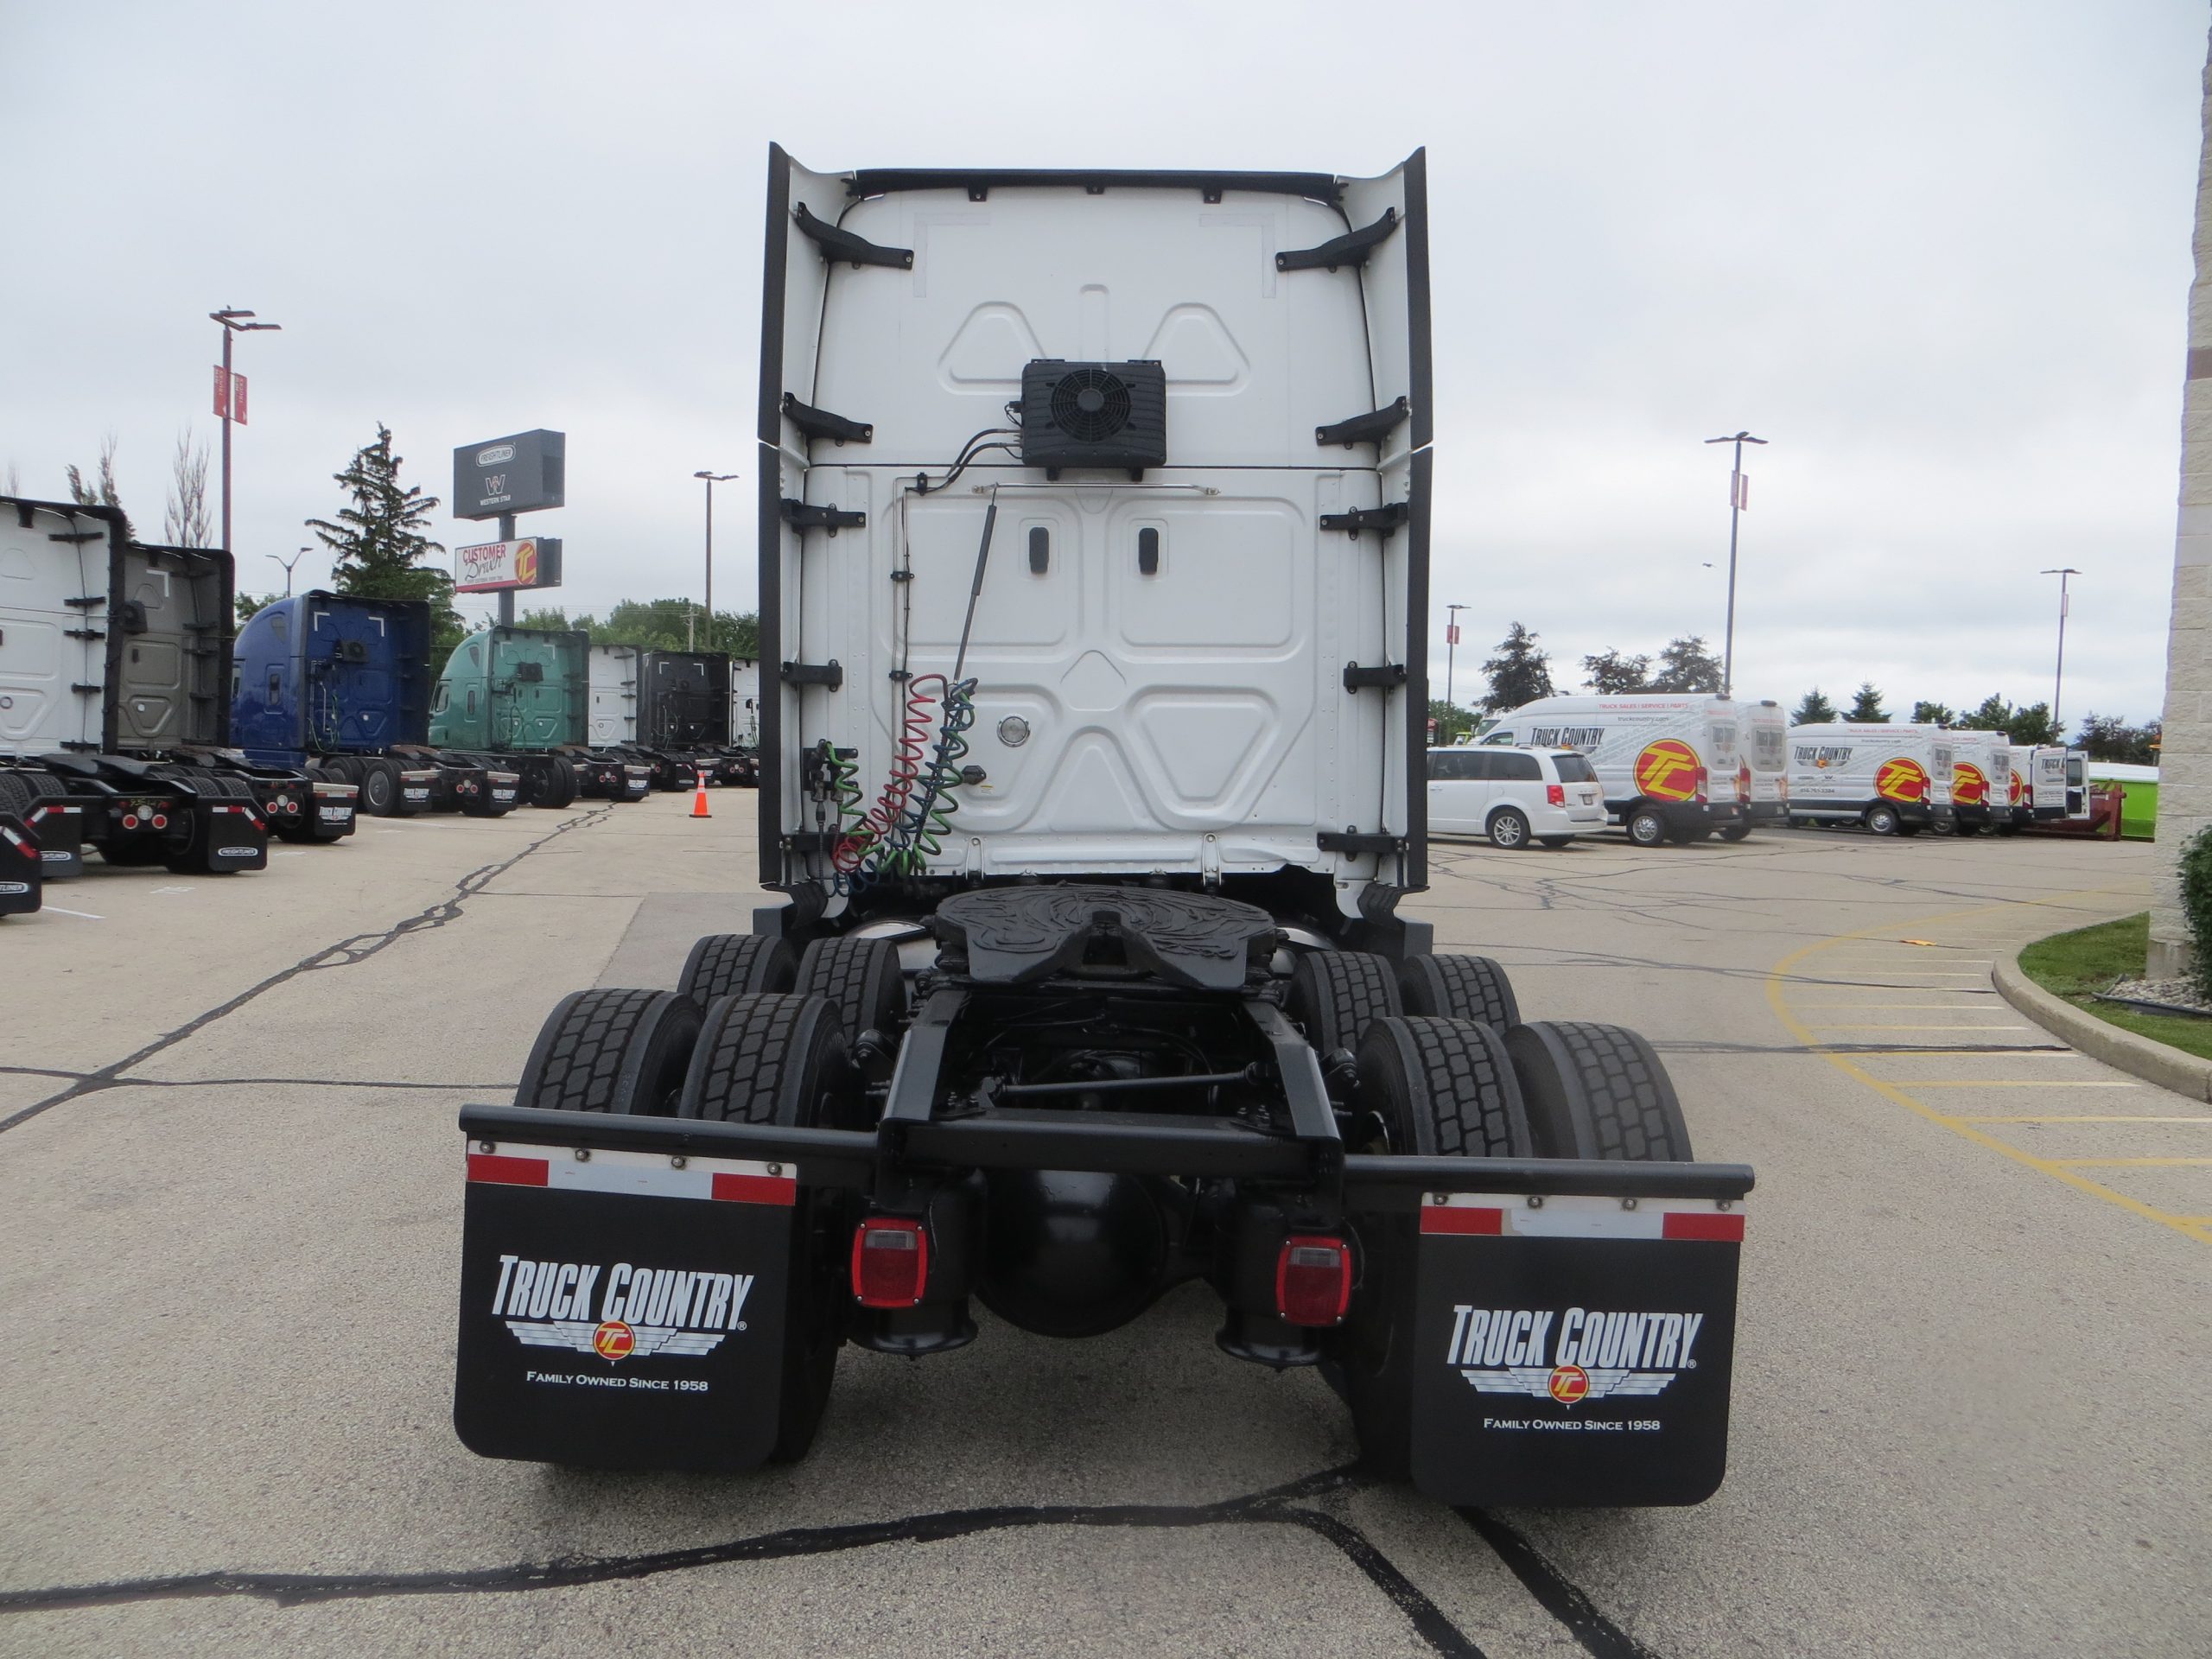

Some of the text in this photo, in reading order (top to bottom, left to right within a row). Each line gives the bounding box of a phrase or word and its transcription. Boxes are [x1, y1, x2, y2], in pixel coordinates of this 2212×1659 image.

[463, 544, 506, 563] CUSTOMER
[1531, 727, 1605, 746] TRUCK COUNTRY
[1794, 746, 1853, 760] TRUCK COUNTRY
[492, 1255, 754, 1330] TRUCK COUNTRY
[1446, 1305, 1703, 1369] TRUCK COUNTRY
[526, 1371, 709, 1392] FAMILY OWNED SINCE 1958
[1484, 1418, 1661, 1431] FAMILY OWNED SINCE 1958
